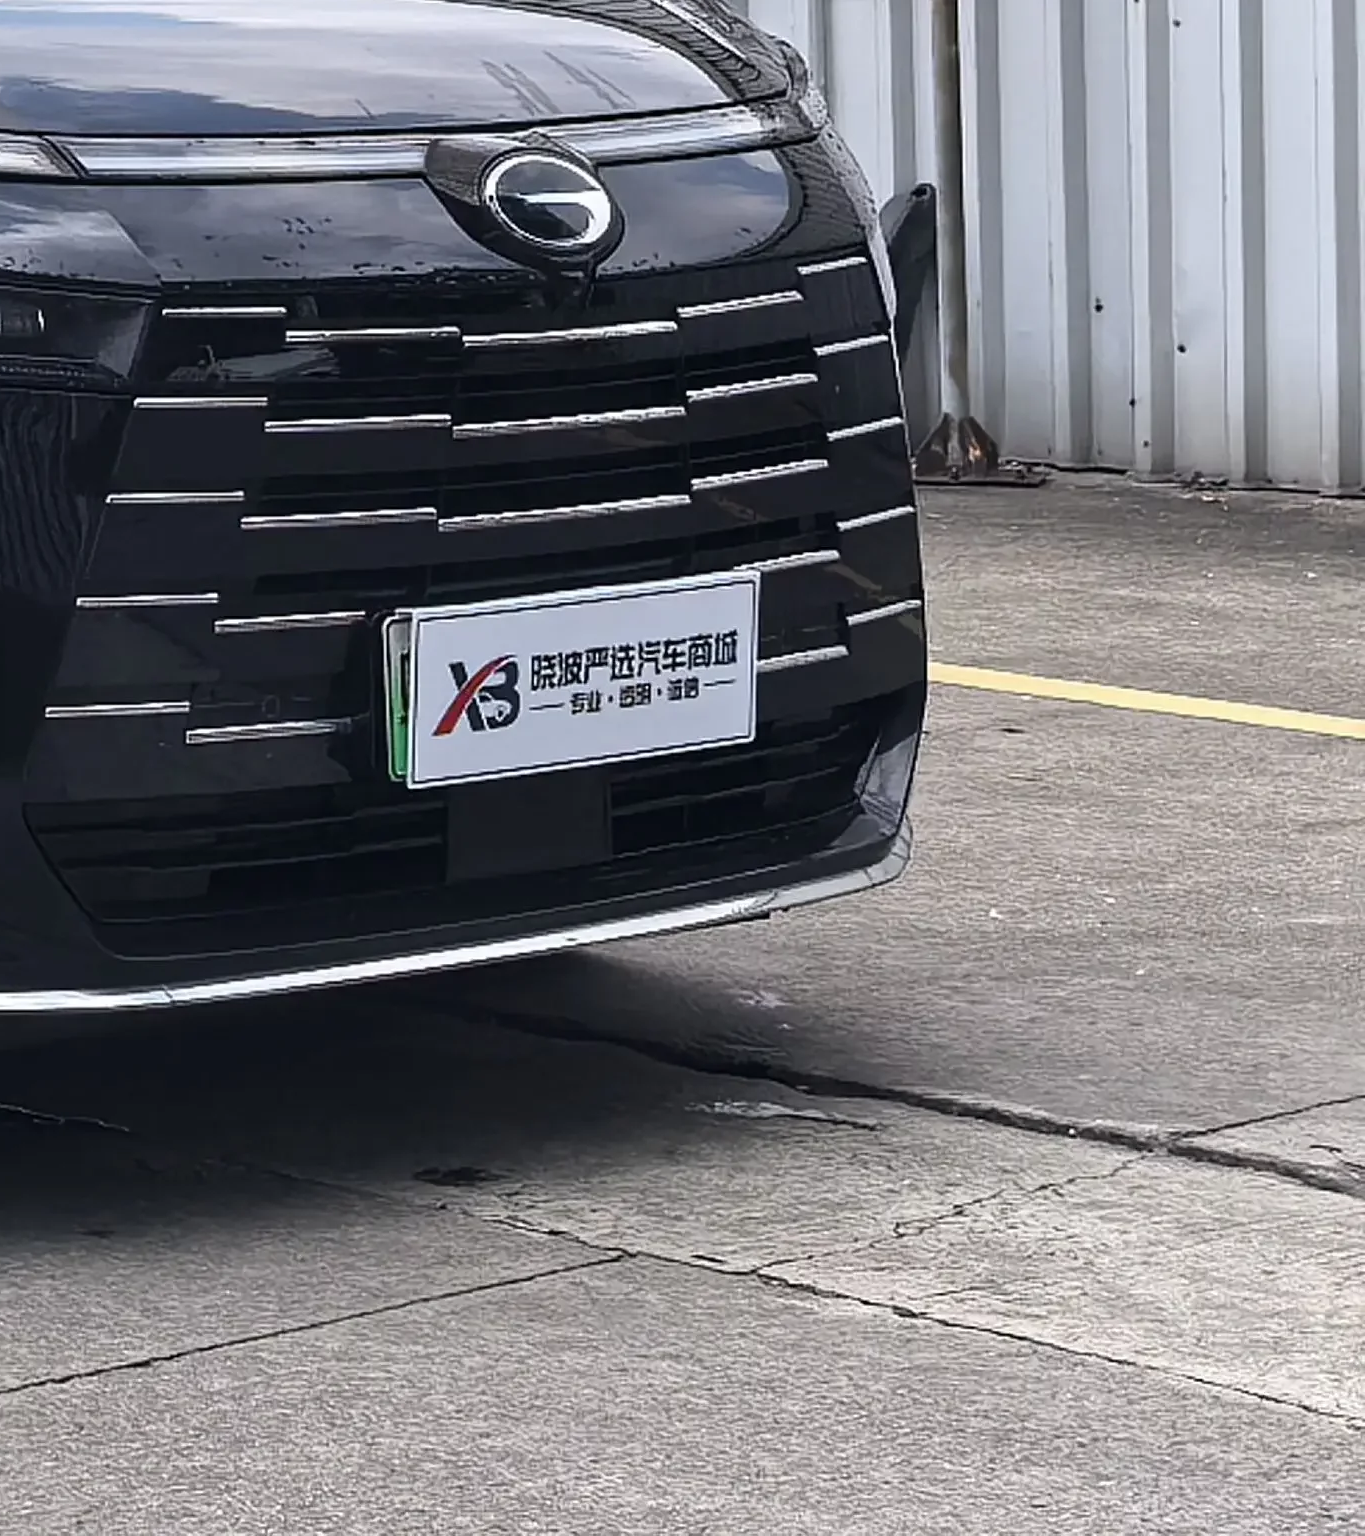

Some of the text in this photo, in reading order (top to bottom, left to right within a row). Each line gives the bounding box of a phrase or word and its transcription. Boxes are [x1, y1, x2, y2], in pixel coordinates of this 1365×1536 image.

[531, 629, 737, 691] 晓波严选汽车商城
